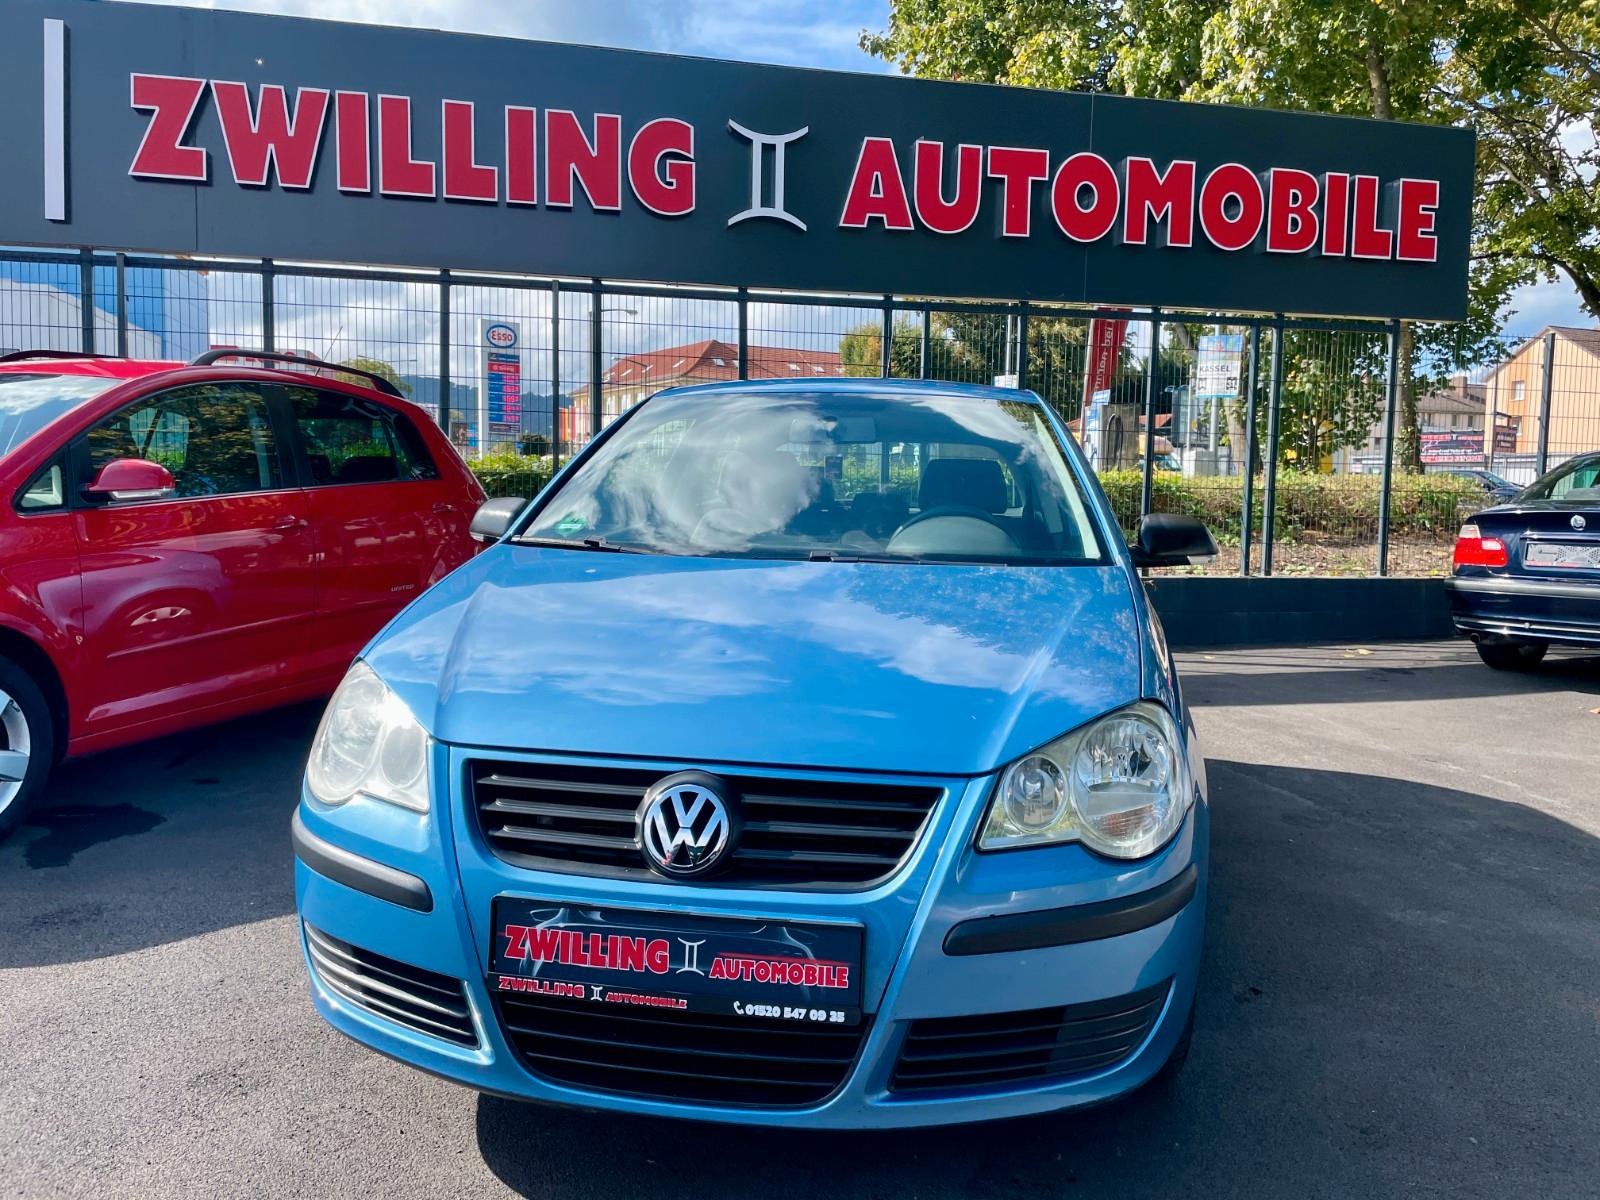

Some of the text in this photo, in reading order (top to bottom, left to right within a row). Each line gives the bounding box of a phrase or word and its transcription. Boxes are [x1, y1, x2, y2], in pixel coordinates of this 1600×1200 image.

[128, 72, 1441, 264] ZWILLING AUTOMOBILE
[504, 924, 849, 989] ZWILLING AUTOMOBILE
[498, 975, 688, 1009] ZWILLING AUTOMOBILE
[745, 1003, 781, 1018] 01520
[783, 1006, 807, 1020] 547
[809, 1009, 827, 1021] 09
